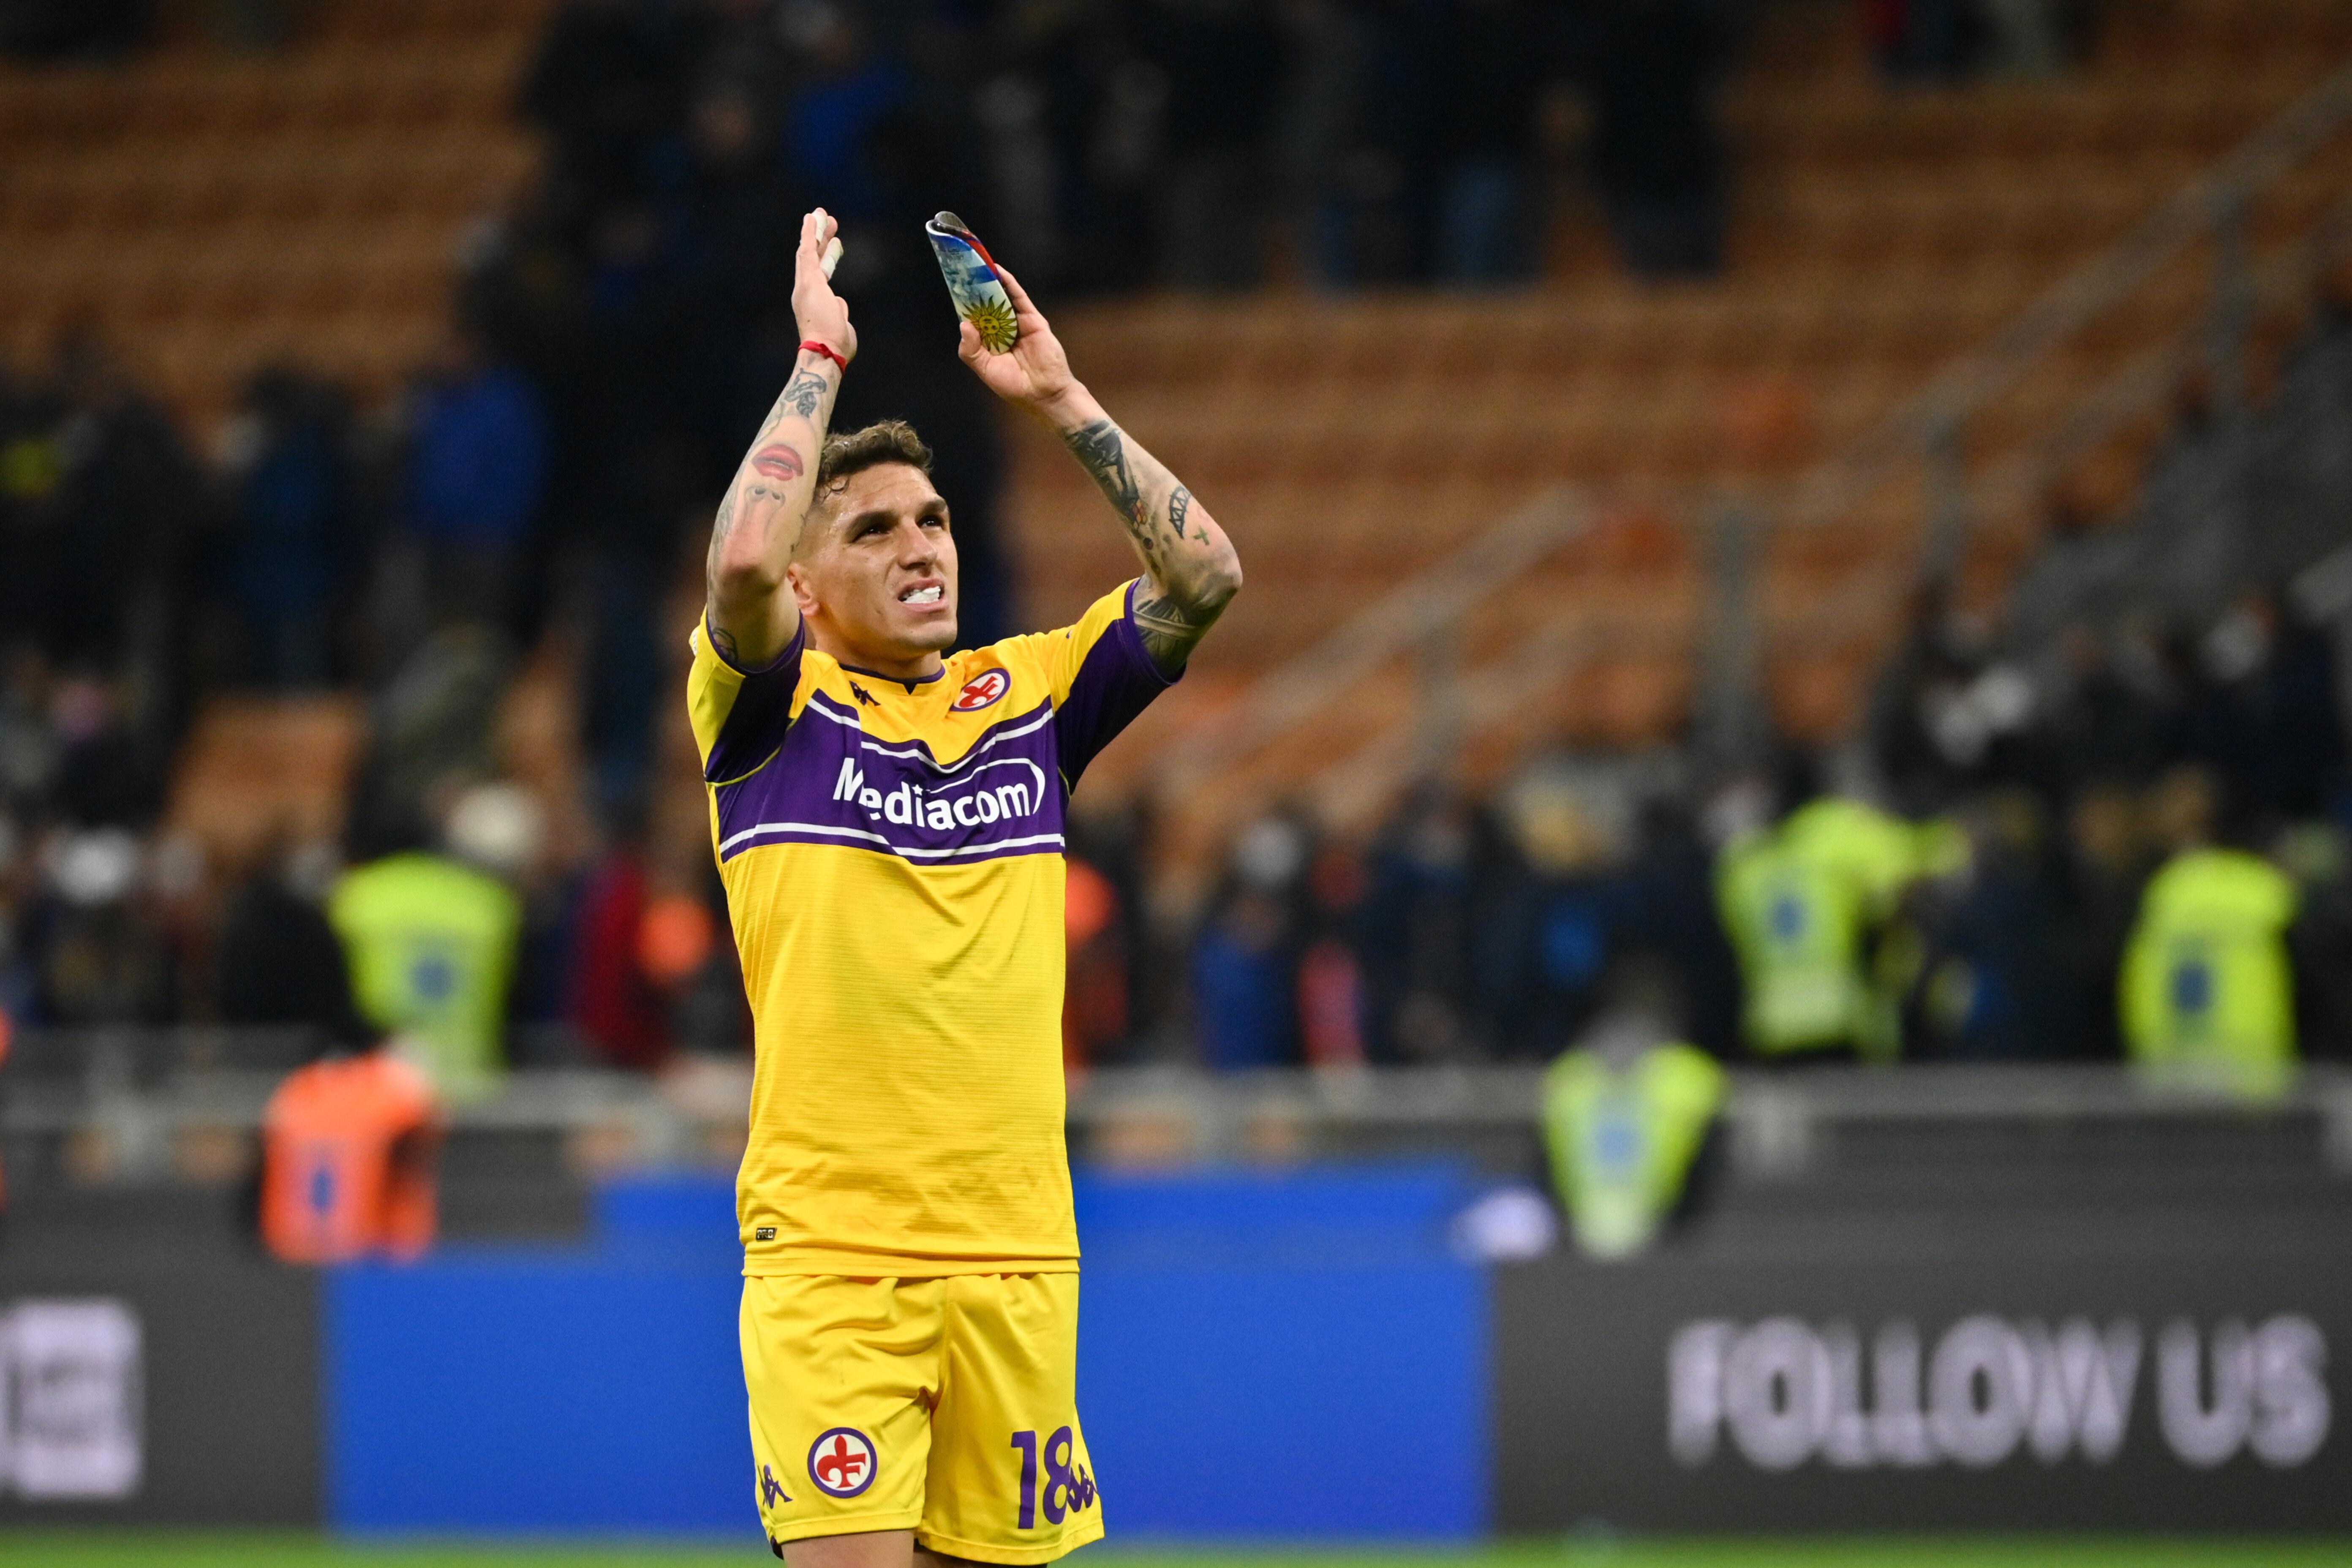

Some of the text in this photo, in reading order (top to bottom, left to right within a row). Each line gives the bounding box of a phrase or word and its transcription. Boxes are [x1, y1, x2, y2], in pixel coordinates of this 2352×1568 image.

[833, 757, 1030, 830] Mediacom
[1668, 1316, 2331, 1468] FOLLOW US
[1011, 1425, 1073, 1529] 18
